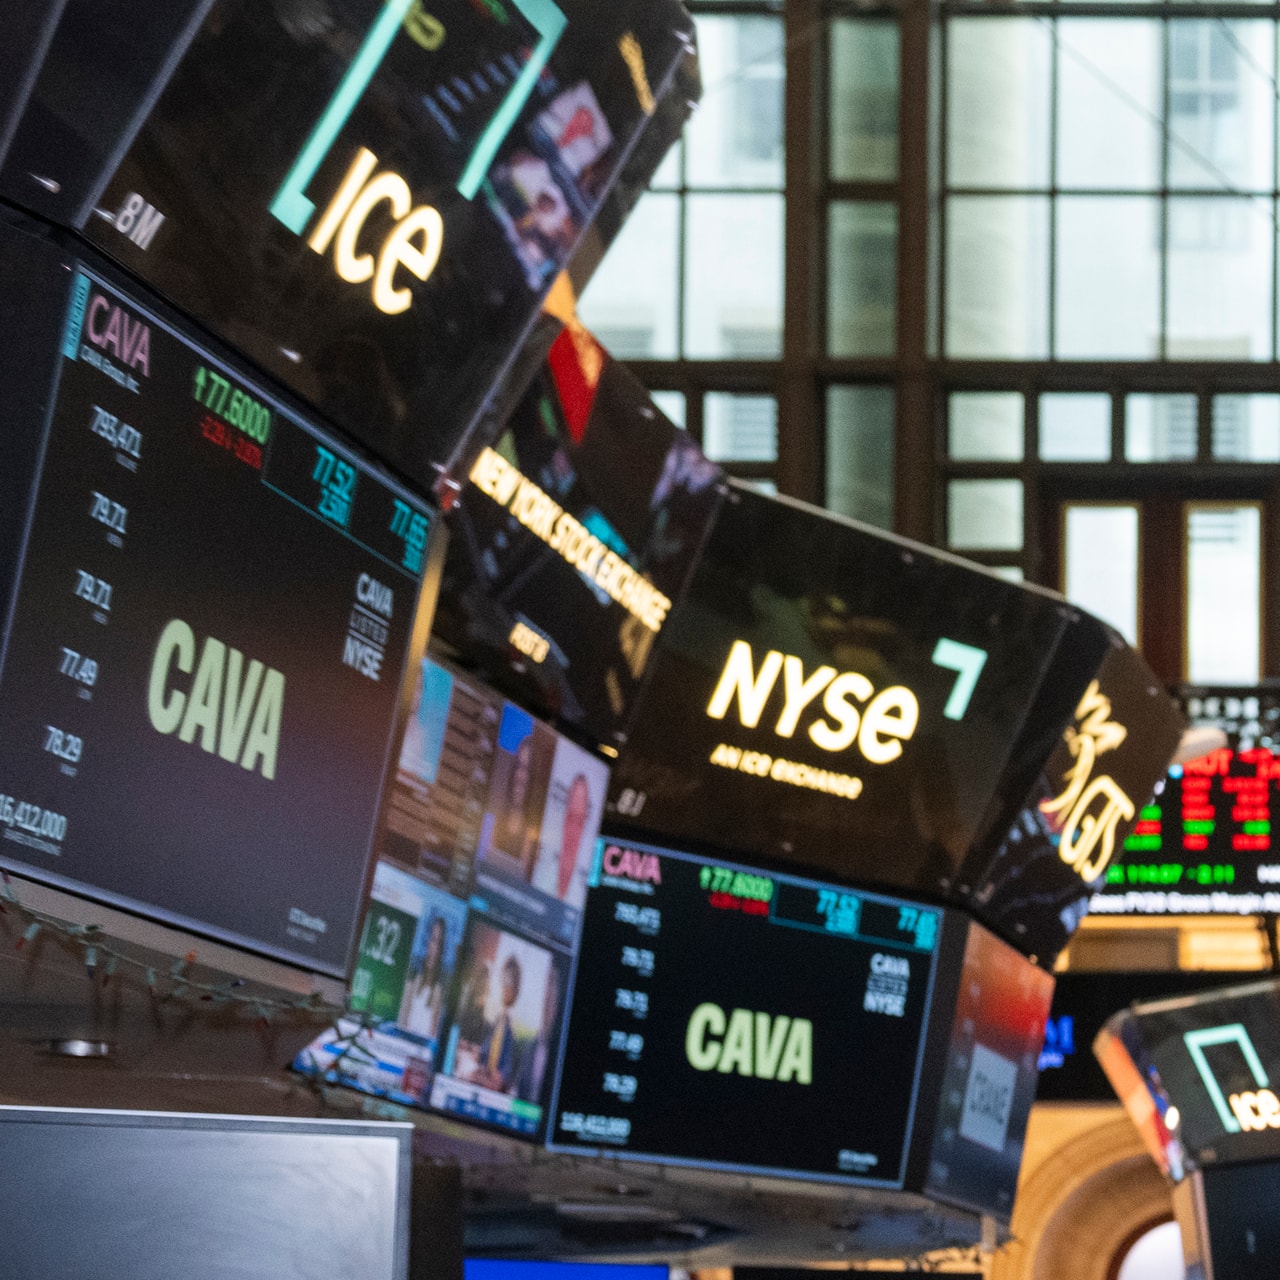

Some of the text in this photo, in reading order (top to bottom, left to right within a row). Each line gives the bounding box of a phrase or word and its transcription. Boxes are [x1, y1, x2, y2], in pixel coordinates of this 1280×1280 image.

[87, 295, 151, 377] CAVA
[148, 618, 286, 781] CAVA
[343, 635, 385, 682] NYSE
[603, 846, 662, 885] CAVA
[685, 1002, 813, 1085] CAVA
